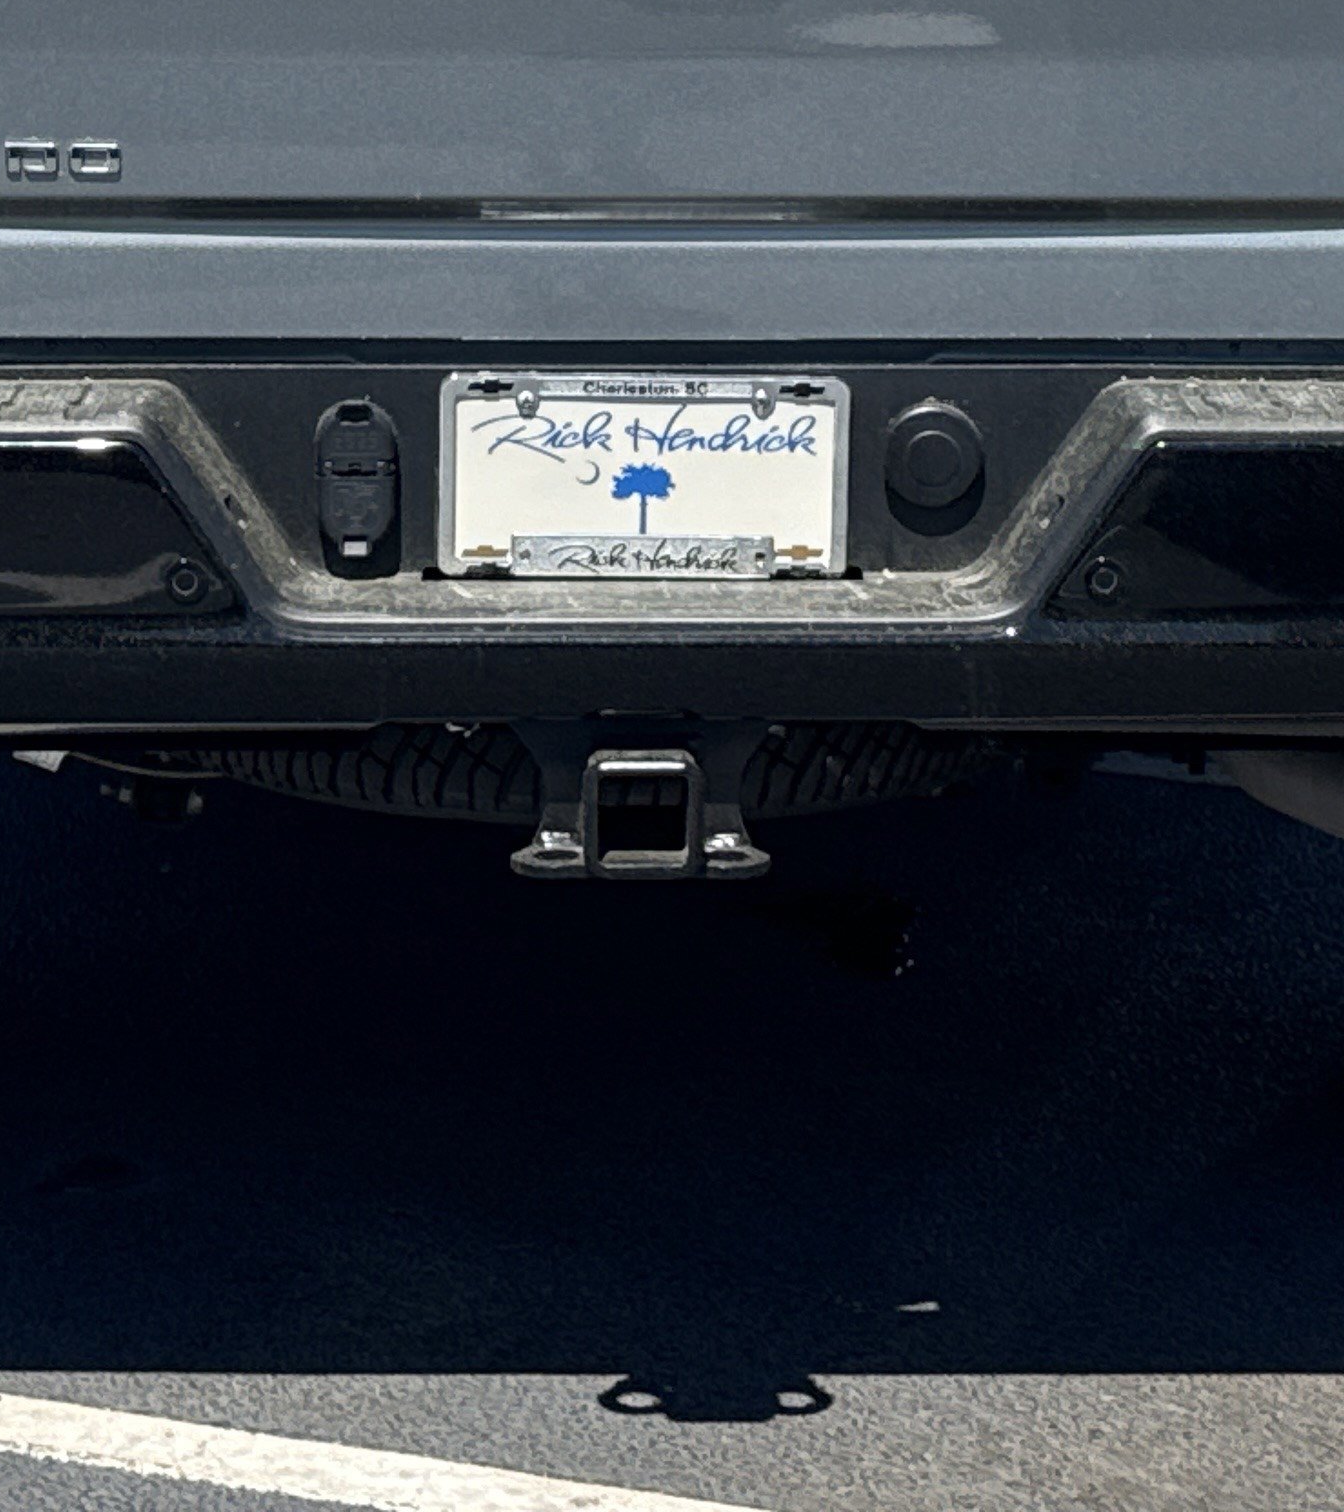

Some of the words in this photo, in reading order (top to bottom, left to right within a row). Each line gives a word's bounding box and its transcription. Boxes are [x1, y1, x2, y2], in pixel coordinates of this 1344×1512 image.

[471, 410, 614, 464] Rick
[624, 403, 818, 457] Hendrick
[547, 542, 628, 575] Rick
